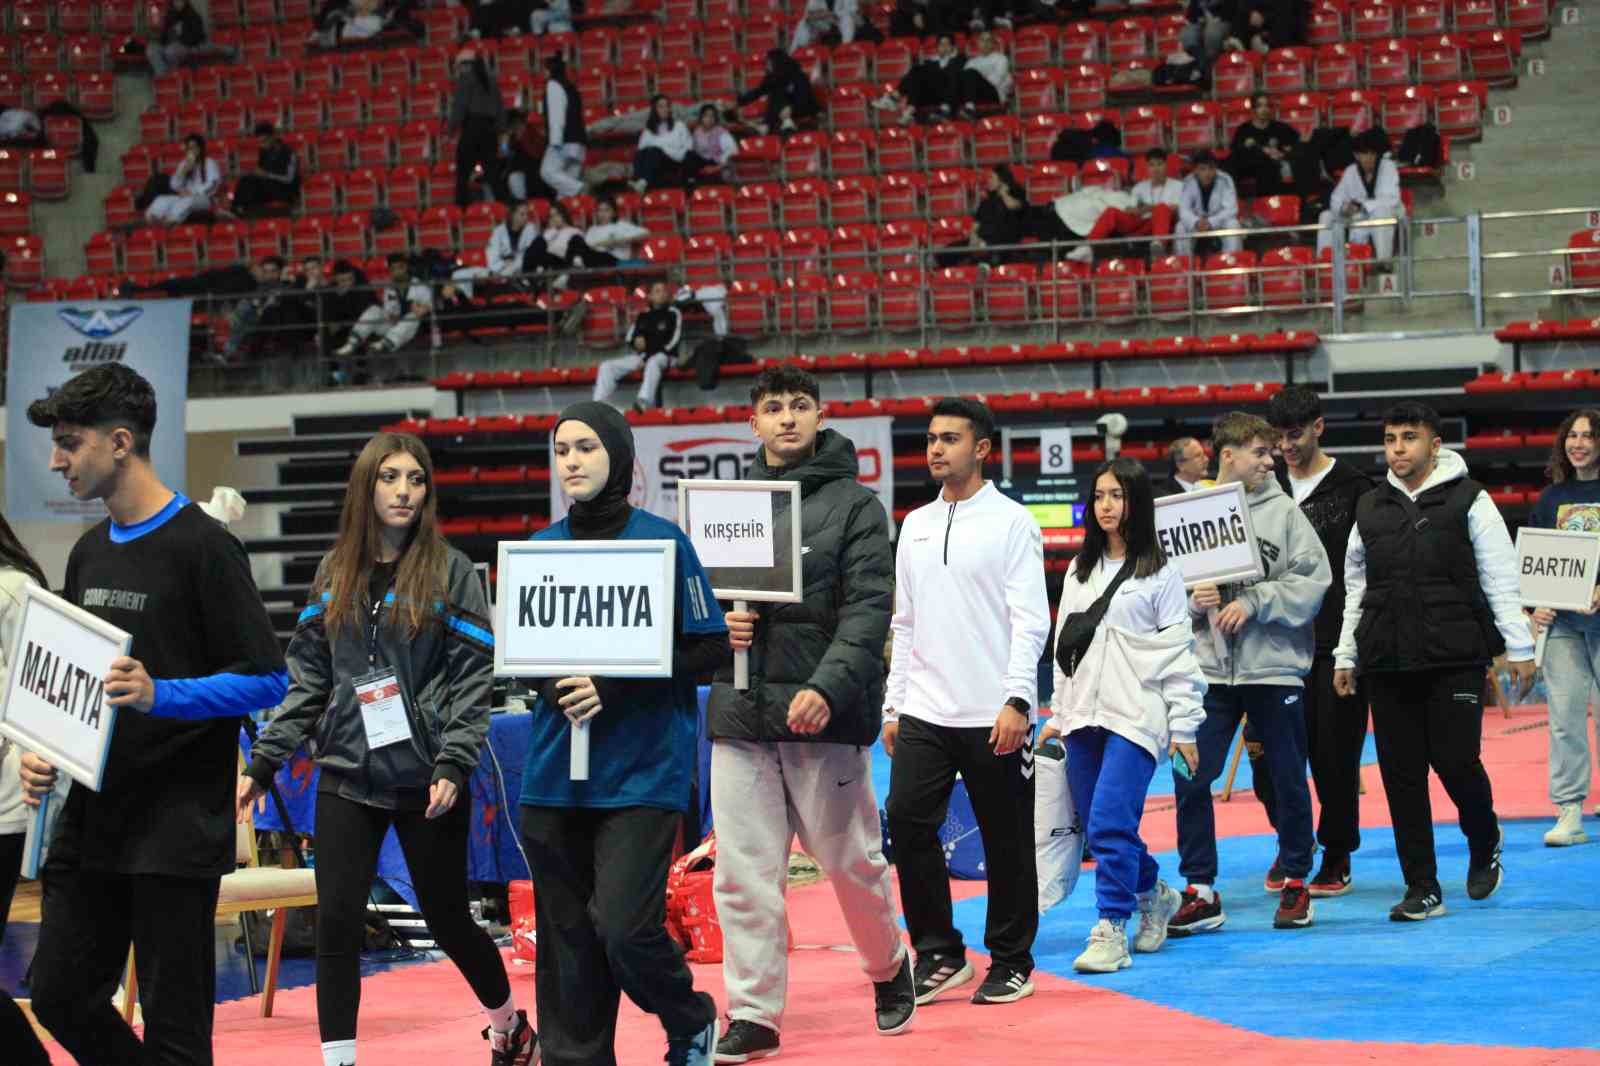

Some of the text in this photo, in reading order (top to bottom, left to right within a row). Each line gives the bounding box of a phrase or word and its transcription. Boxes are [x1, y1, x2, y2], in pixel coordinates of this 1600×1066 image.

[1048, 444, 1063, 468] 8
[704, 519, 764, 542] KIRŞEHİR
[1157, 506, 1247, 558] EKİRDAĞ
[1521, 556, 1586, 578] BARTIN
[518, 574, 653, 628] KÜTAHYA
[19, 640, 105, 730] MALATYA
